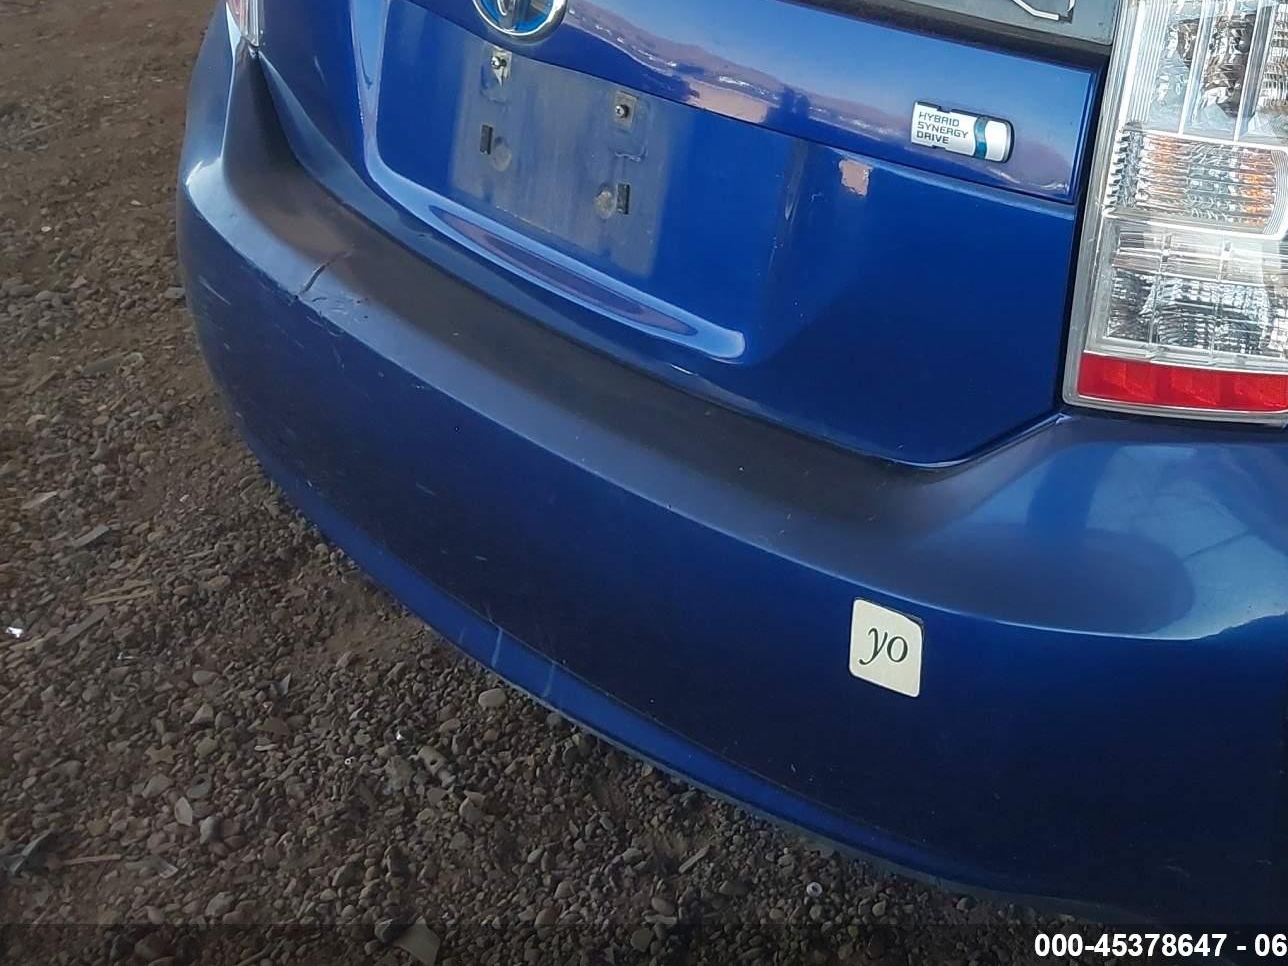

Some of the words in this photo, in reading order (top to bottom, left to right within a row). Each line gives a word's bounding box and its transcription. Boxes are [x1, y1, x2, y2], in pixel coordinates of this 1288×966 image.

[918, 111, 961, 128] HYBRID
[916, 121, 969, 139] SYNERGY
[916, 130, 950, 145] DRIVE
[858, 627, 909, 666] yo
